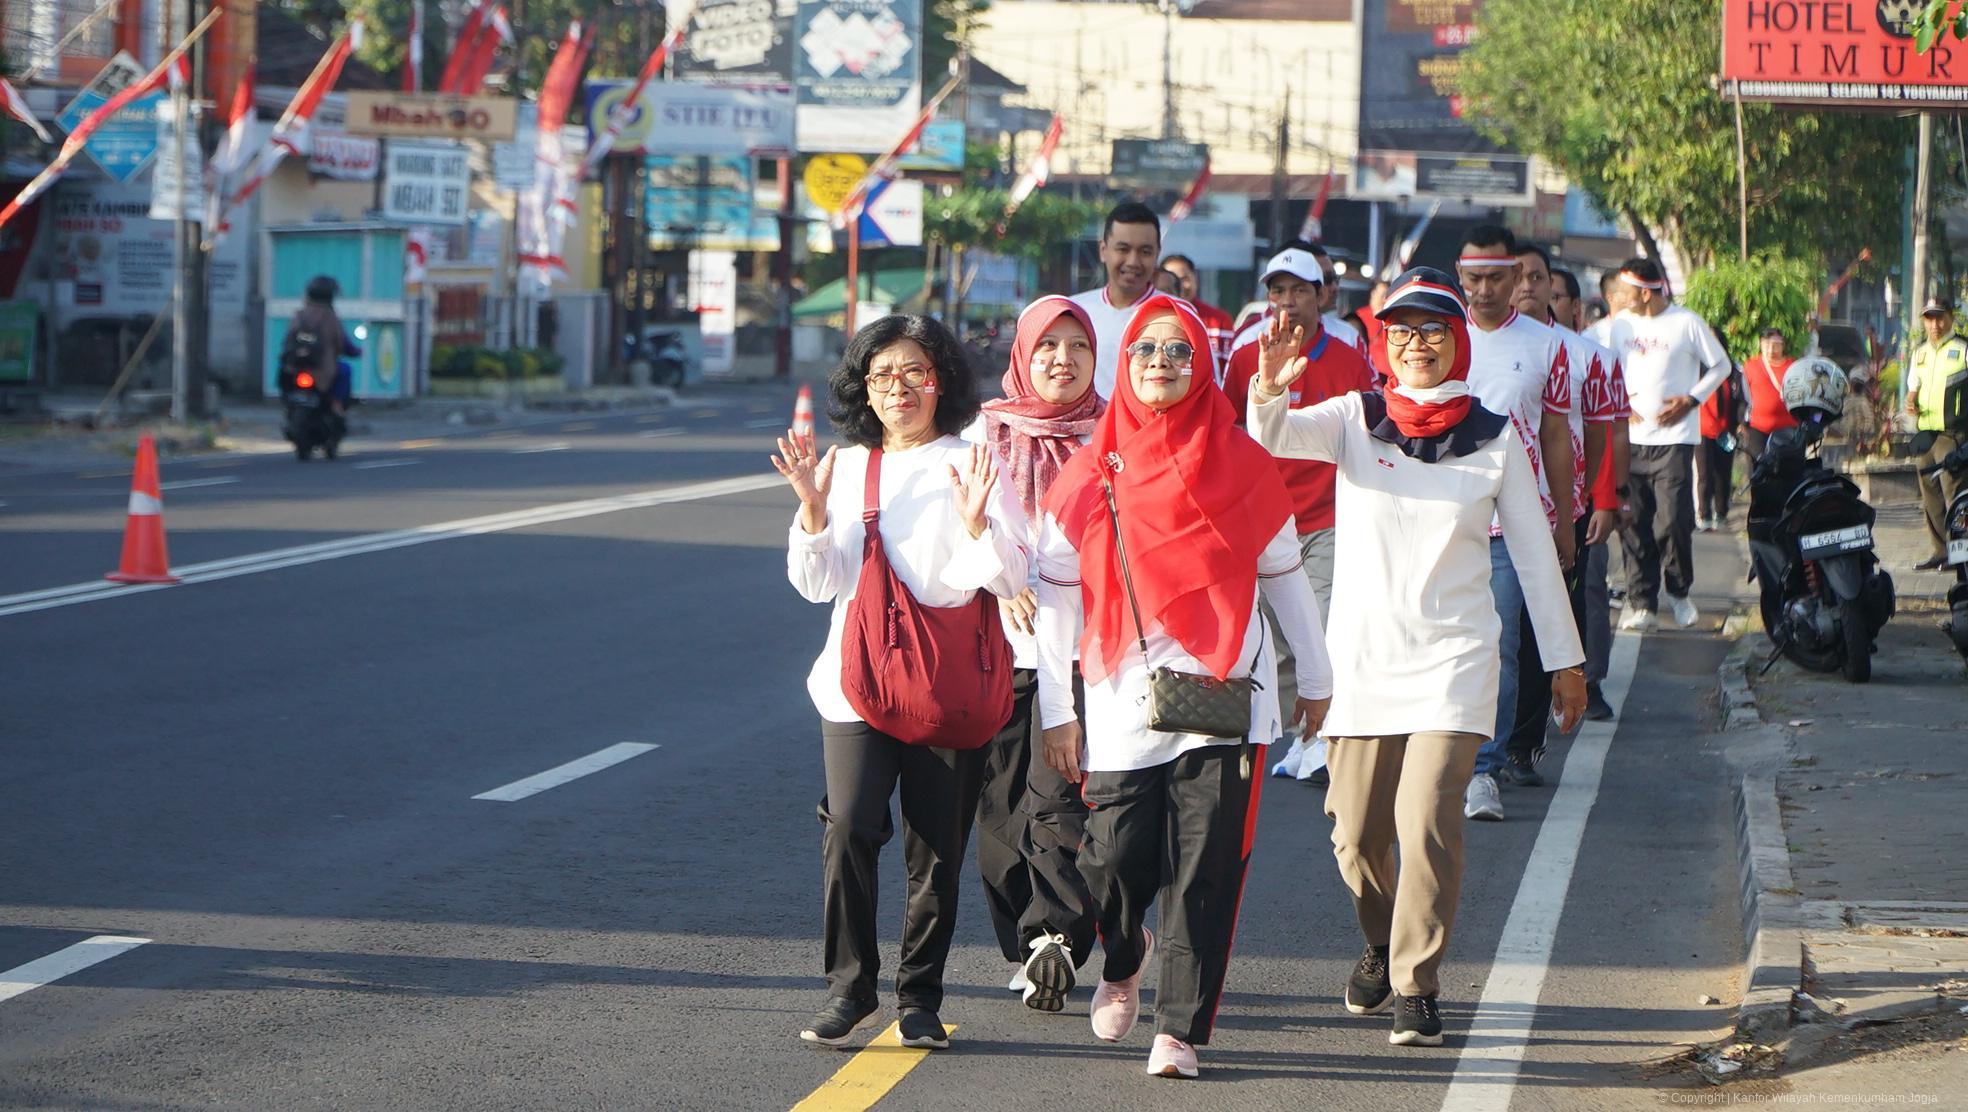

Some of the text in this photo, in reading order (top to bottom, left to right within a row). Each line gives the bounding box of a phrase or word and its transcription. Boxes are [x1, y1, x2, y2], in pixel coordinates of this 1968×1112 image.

[1748, 1, 1866, 33] HOTEL
[1749, 41, 1953, 79] TIMUR
[1830, 82, 1879, 99] SELATAN
[1880, 84, 1901, 99] 142
